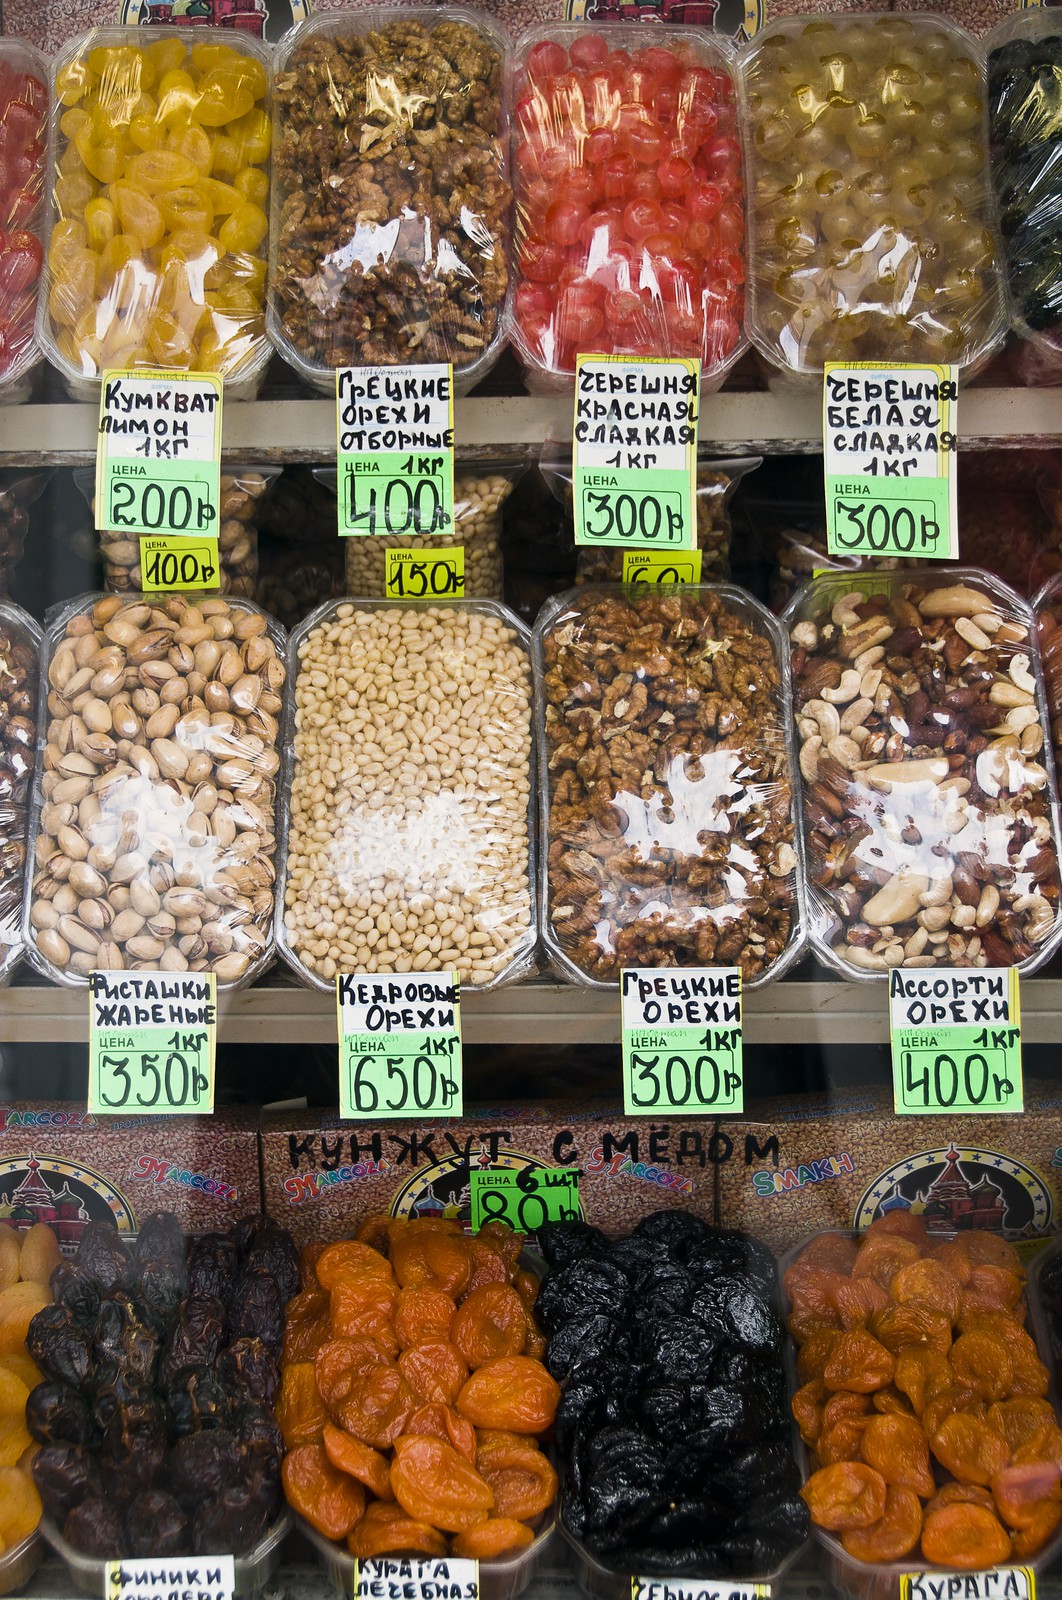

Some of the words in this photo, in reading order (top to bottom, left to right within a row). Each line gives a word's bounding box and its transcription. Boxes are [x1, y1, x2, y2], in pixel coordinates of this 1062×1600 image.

[338, 370, 452, 405] ГРЕЦКИЕ
[578, 367, 698, 397] ЧЕРЕШНЯ
[826, 374, 958, 404] ЧЕРЕШНЯ
[104, 381, 219, 413] КУМКВАТ
[341, 403, 431, 425] ОРЕХИ
[576, 398, 699, 421] КРАСНАЯ
[828, 405, 941, 427] БЕЛАЯ
[99, 415, 189, 436] ЛИМОН
[575, 425, 696, 446] СЛАДКАЯ
[339, 429, 454, 451] ОТБОРНЫЕ
[833, 431, 958, 454] СЛАДКАЯ
[111, 464, 147, 477] ЦЕНА
[344, 460, 380, 474] ЦЕНА
[583, 475, 618, 487] ЦЕНА
[834, 484, 871, 496] ЦЕНА
[144, 540, 168, 550] ЦЕНА
[390, 552, 414, 561] ЦЕНА
[628, 555, 651, 564] ЦЕНА
[338, 973, 461, 1007] КЕДРОВЫЕ
[622, 972, 743, 1003] ГРЕЦКИЕ
[890, 971, 1004, 1001] АССОРТИ
[95, 1003, 216, 1027] ЖАРЕНЫЕ
[364, 1007, 455, 1033] ОРЕХИ
[642, 1000, 741, 1024] ОРЕХИ
[906, 998, 1010, 1025] ОРЕХИ
[99, 1038, 135, 1049] ЦЕНА
[349, 1042, 386, 1053] ЦЕНА
[631, 1037, 667, 1049] ЦЕНА
[901, 1036, 938, 1048] ЦЕНА
[289, 1131, 513, 1171] КУНЖУТ
[602, 1125, 780, 1168] МЁДОМ
[132, 1153, 240, 1205] MARCOZA
[283, 1158, 393, 1206] MARCOZA
[477, 1176, 511, 1186] ЦЕНА
[584, 1146, 696, 1197] MARCOZA
[752, 1150, 855, 1198] SMAKH
[110, 1566, 222, 1590] ФИНИКИ
[907, 1570, 1020, 1600] КУРАГА
